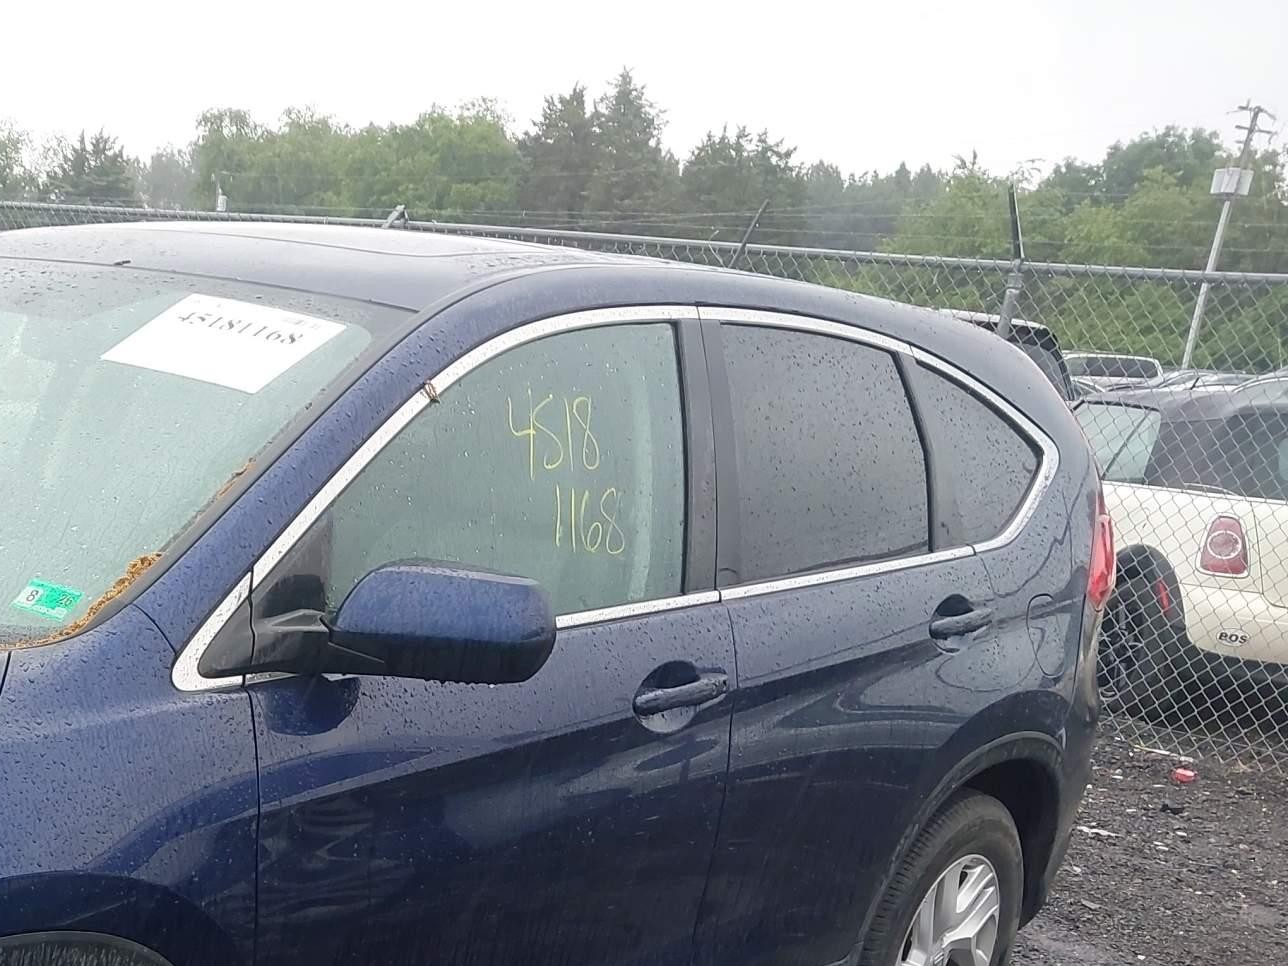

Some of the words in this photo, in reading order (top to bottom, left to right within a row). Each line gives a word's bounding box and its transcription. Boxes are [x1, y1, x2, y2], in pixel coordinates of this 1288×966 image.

[177, 311, 304, 345] 45181168
[506, 383, 601, 480] 4518
[555, 484, 626, 554] 1168
[26, 589, 40, 602] 8
